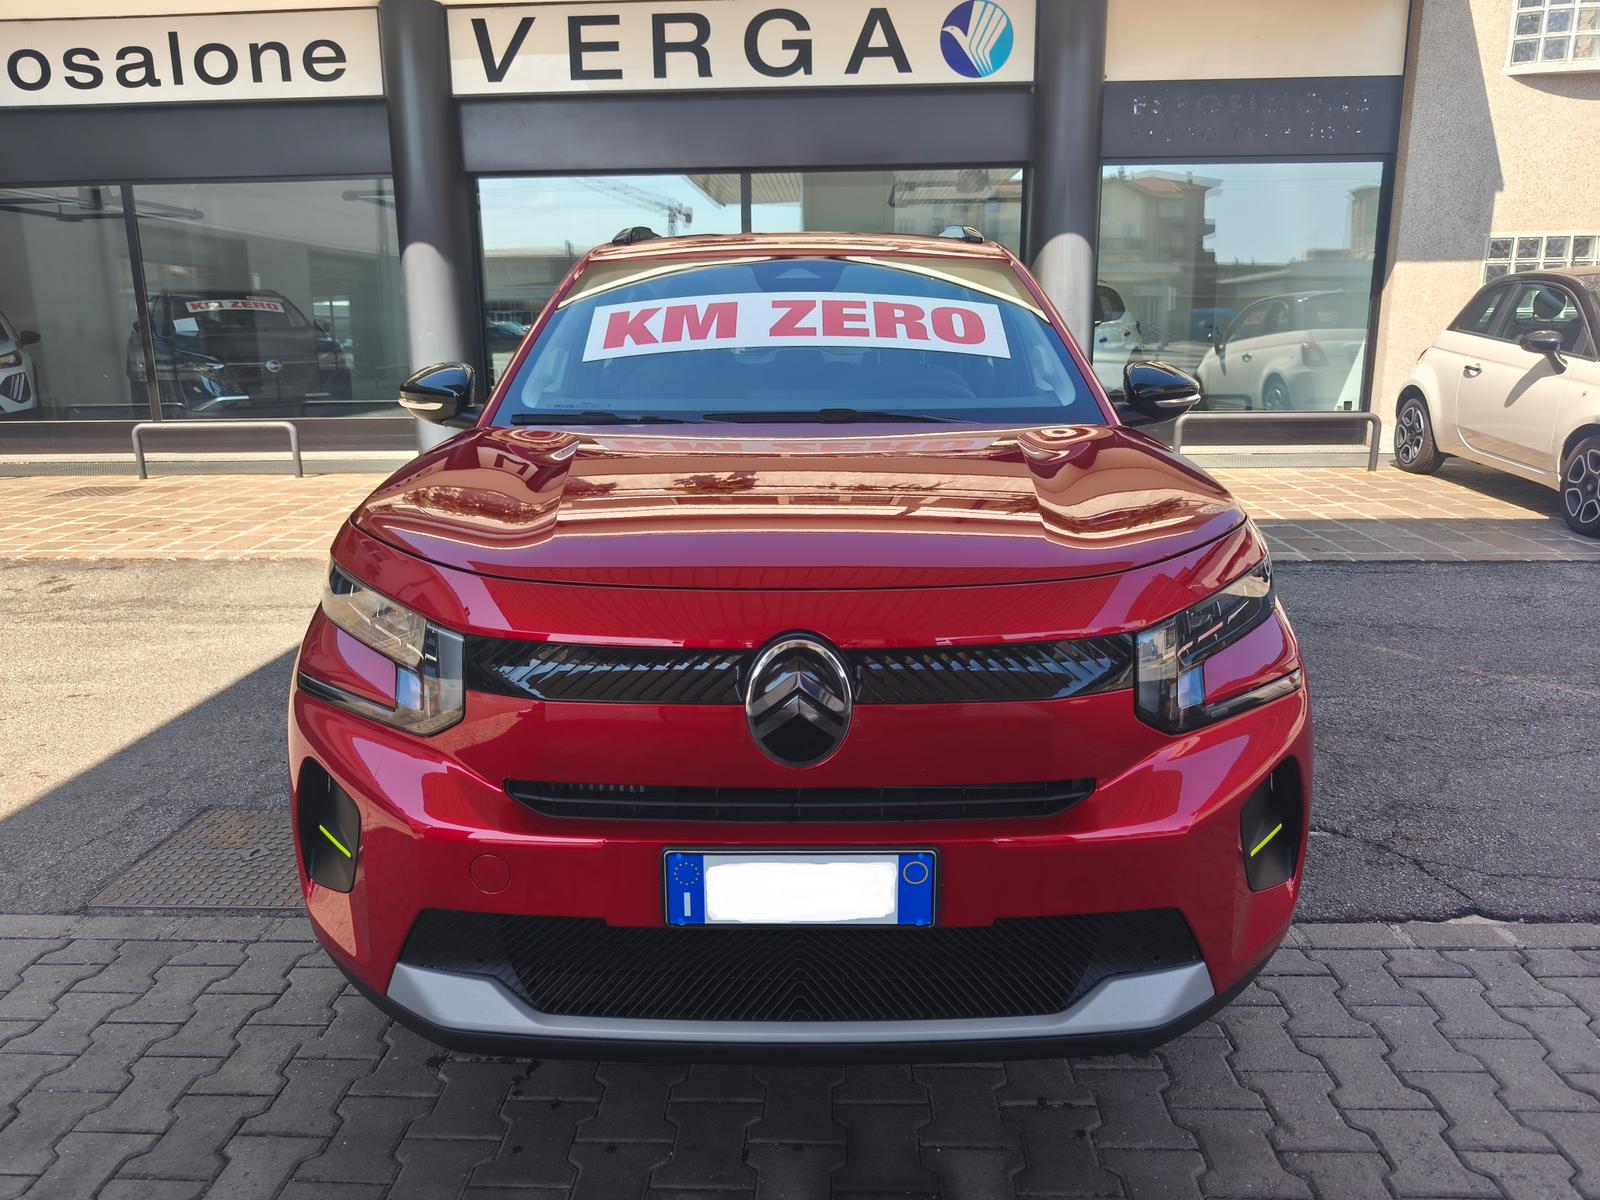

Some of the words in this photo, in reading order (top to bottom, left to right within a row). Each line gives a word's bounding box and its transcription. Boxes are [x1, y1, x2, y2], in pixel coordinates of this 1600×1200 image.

[7, 32, 347, 91] osalone
[471, 7, 913, 83] VERGA
[230, 301, 279, 310] ZERO
[604, 303, 738, 349] KM
[769, 300, 986, 345] ZERO
